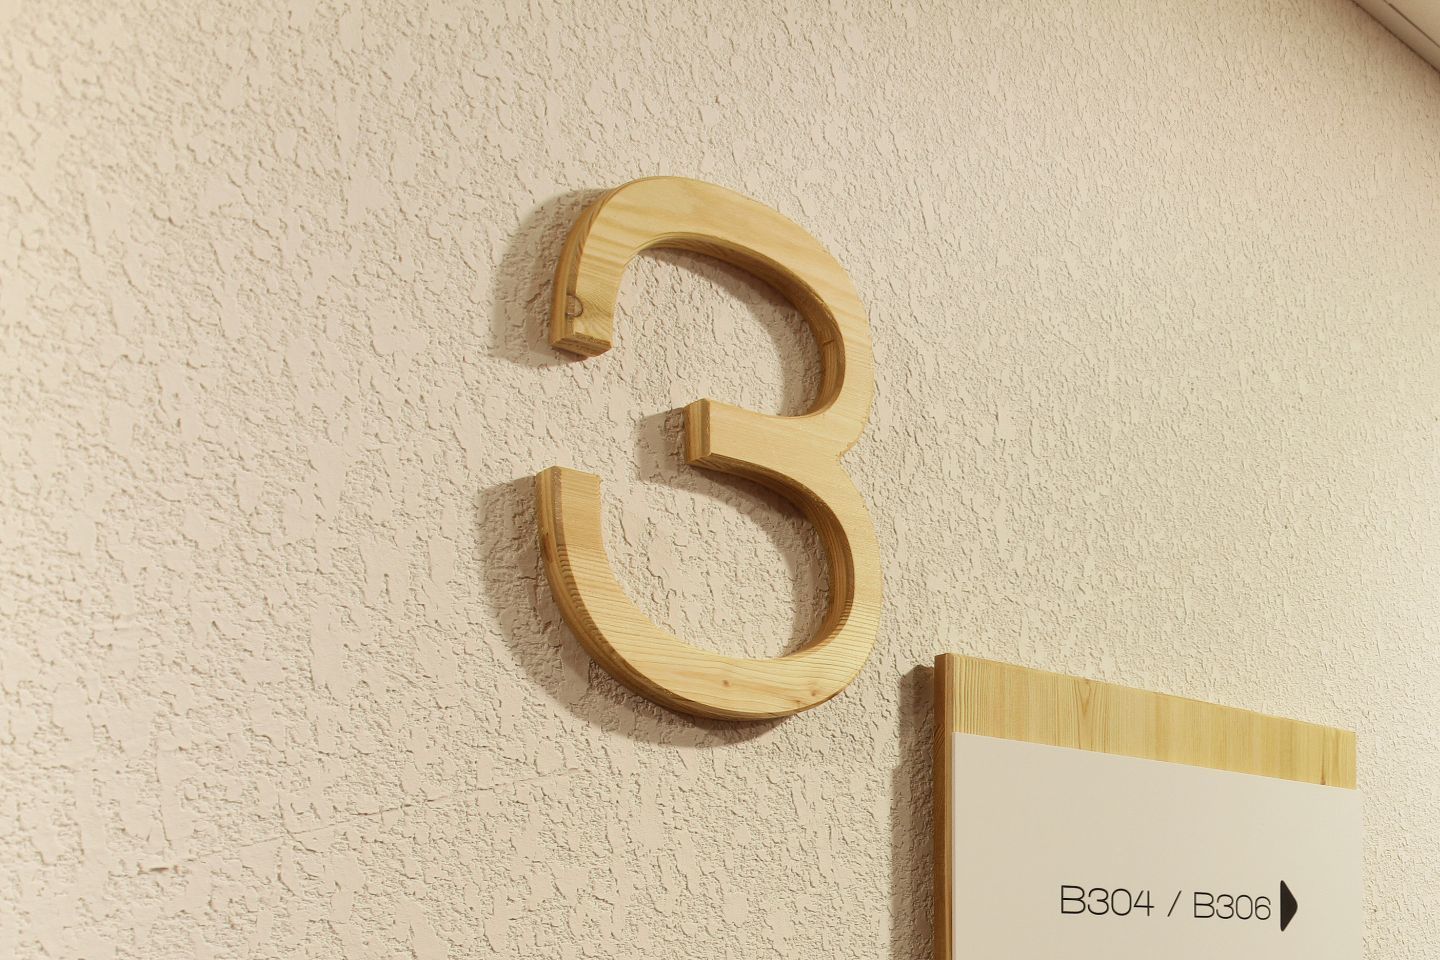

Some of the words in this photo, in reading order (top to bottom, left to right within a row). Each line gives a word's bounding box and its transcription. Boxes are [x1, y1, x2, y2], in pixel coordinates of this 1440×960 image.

[535, 176, 882, 721] 3
[1060, 884, 1155, 917] B304
[1167, 890, 1182, 917] /
[1193, 891, 1272, 921] B306
